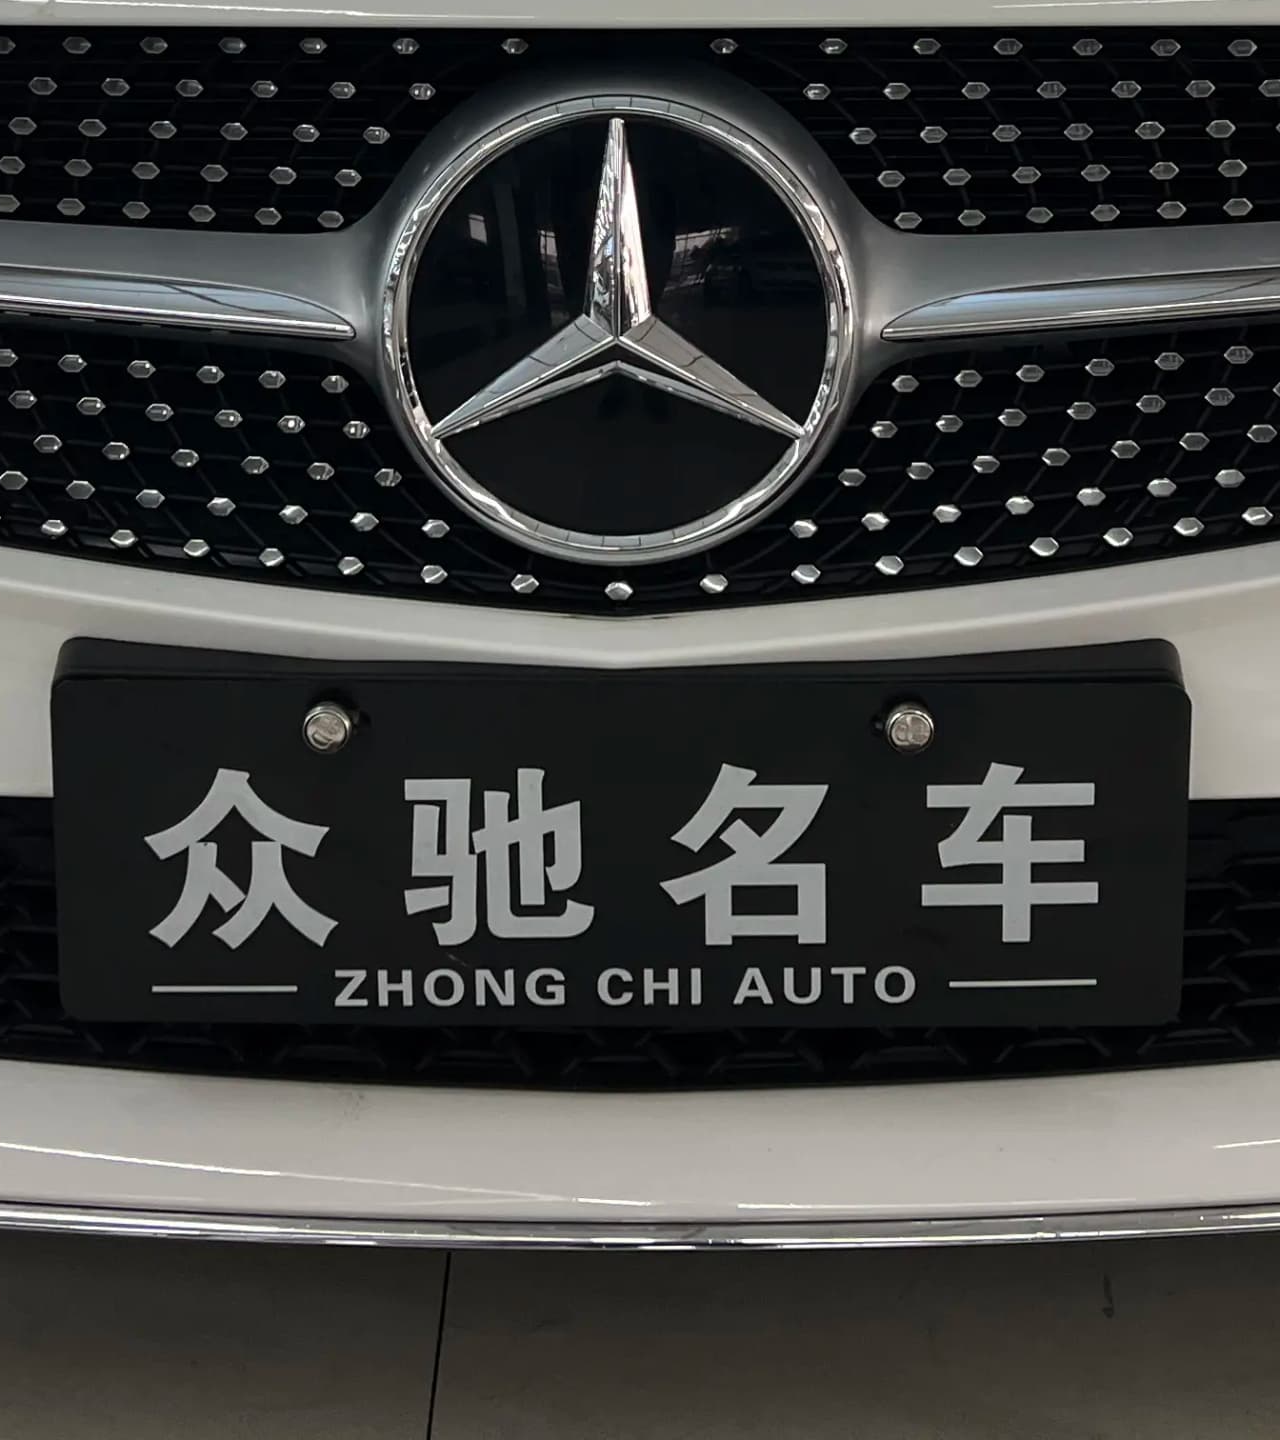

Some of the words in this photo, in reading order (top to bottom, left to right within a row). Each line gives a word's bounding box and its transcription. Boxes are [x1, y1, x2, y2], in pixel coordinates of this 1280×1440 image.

[145, 762, 1100, 949] 众驰名车
[334, 968, 566, 1008] ZHONG
[596, 967, 703, 1006] CHI
[733, 965, 918, 1005] AUTO
